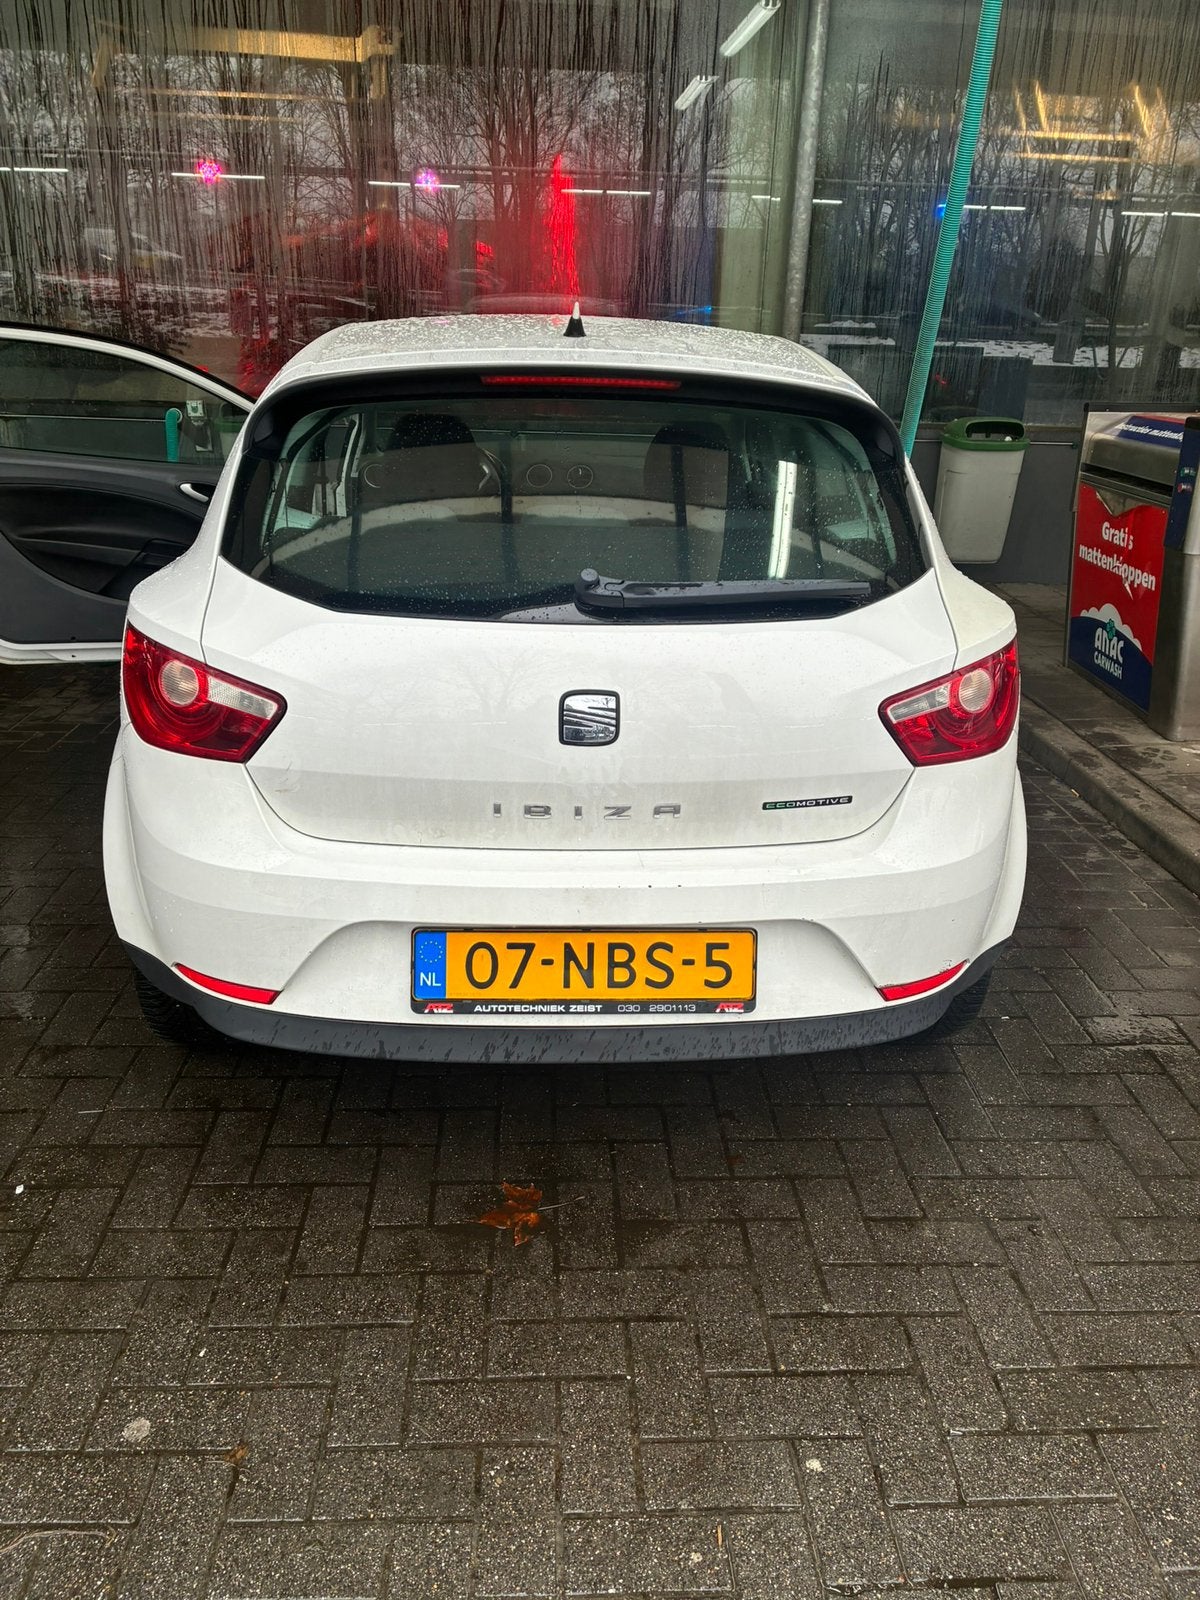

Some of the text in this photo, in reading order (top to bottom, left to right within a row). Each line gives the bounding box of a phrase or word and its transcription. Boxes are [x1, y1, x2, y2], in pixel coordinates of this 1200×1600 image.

[1102, 521, 1134, 550] Gratis
[1093, 651, 1123, 680] CARWASH
[766, 796, 850, 809] ECOMOTIVE
[493, 803, 682, 820] IBIZA
[465, 941, 733, 990] 07-NBS-5
[420, 972, 441, 987] NL
[474, 1004, 566, 1013] AUTOTECHNIEK
[569, 1004, 603, 1013] ZEIST
[617, 1004, 641, 1013] 030
[648, 1004, 696, 1013] 2901113
